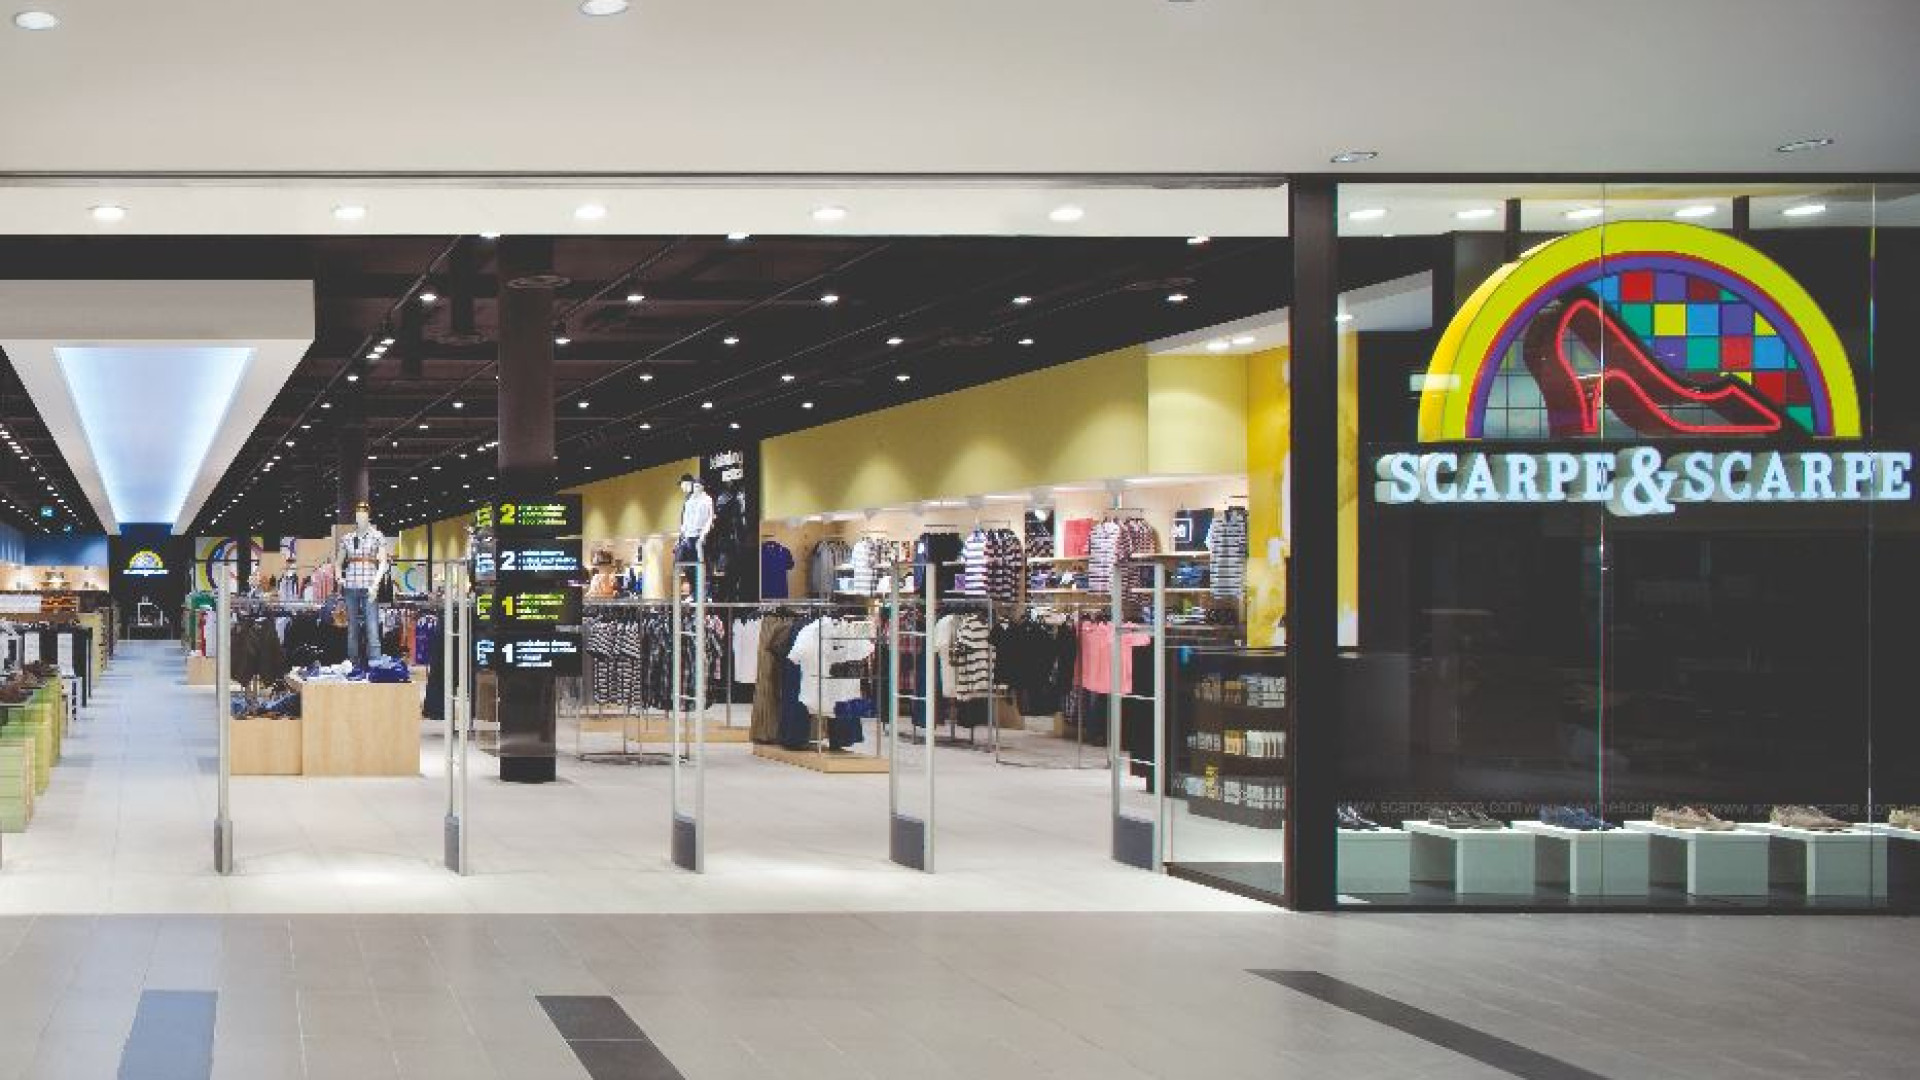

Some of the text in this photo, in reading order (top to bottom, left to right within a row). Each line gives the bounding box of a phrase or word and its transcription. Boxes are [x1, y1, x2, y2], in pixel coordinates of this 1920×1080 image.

[1376, 446, 1911, 515] SCARPE&SCARPE
[500, 504, 515, 525] 2
[500, 551, 516, 570] 2
[502, 596, 513, 616] 1
[502, 643, 513, 663] 1
